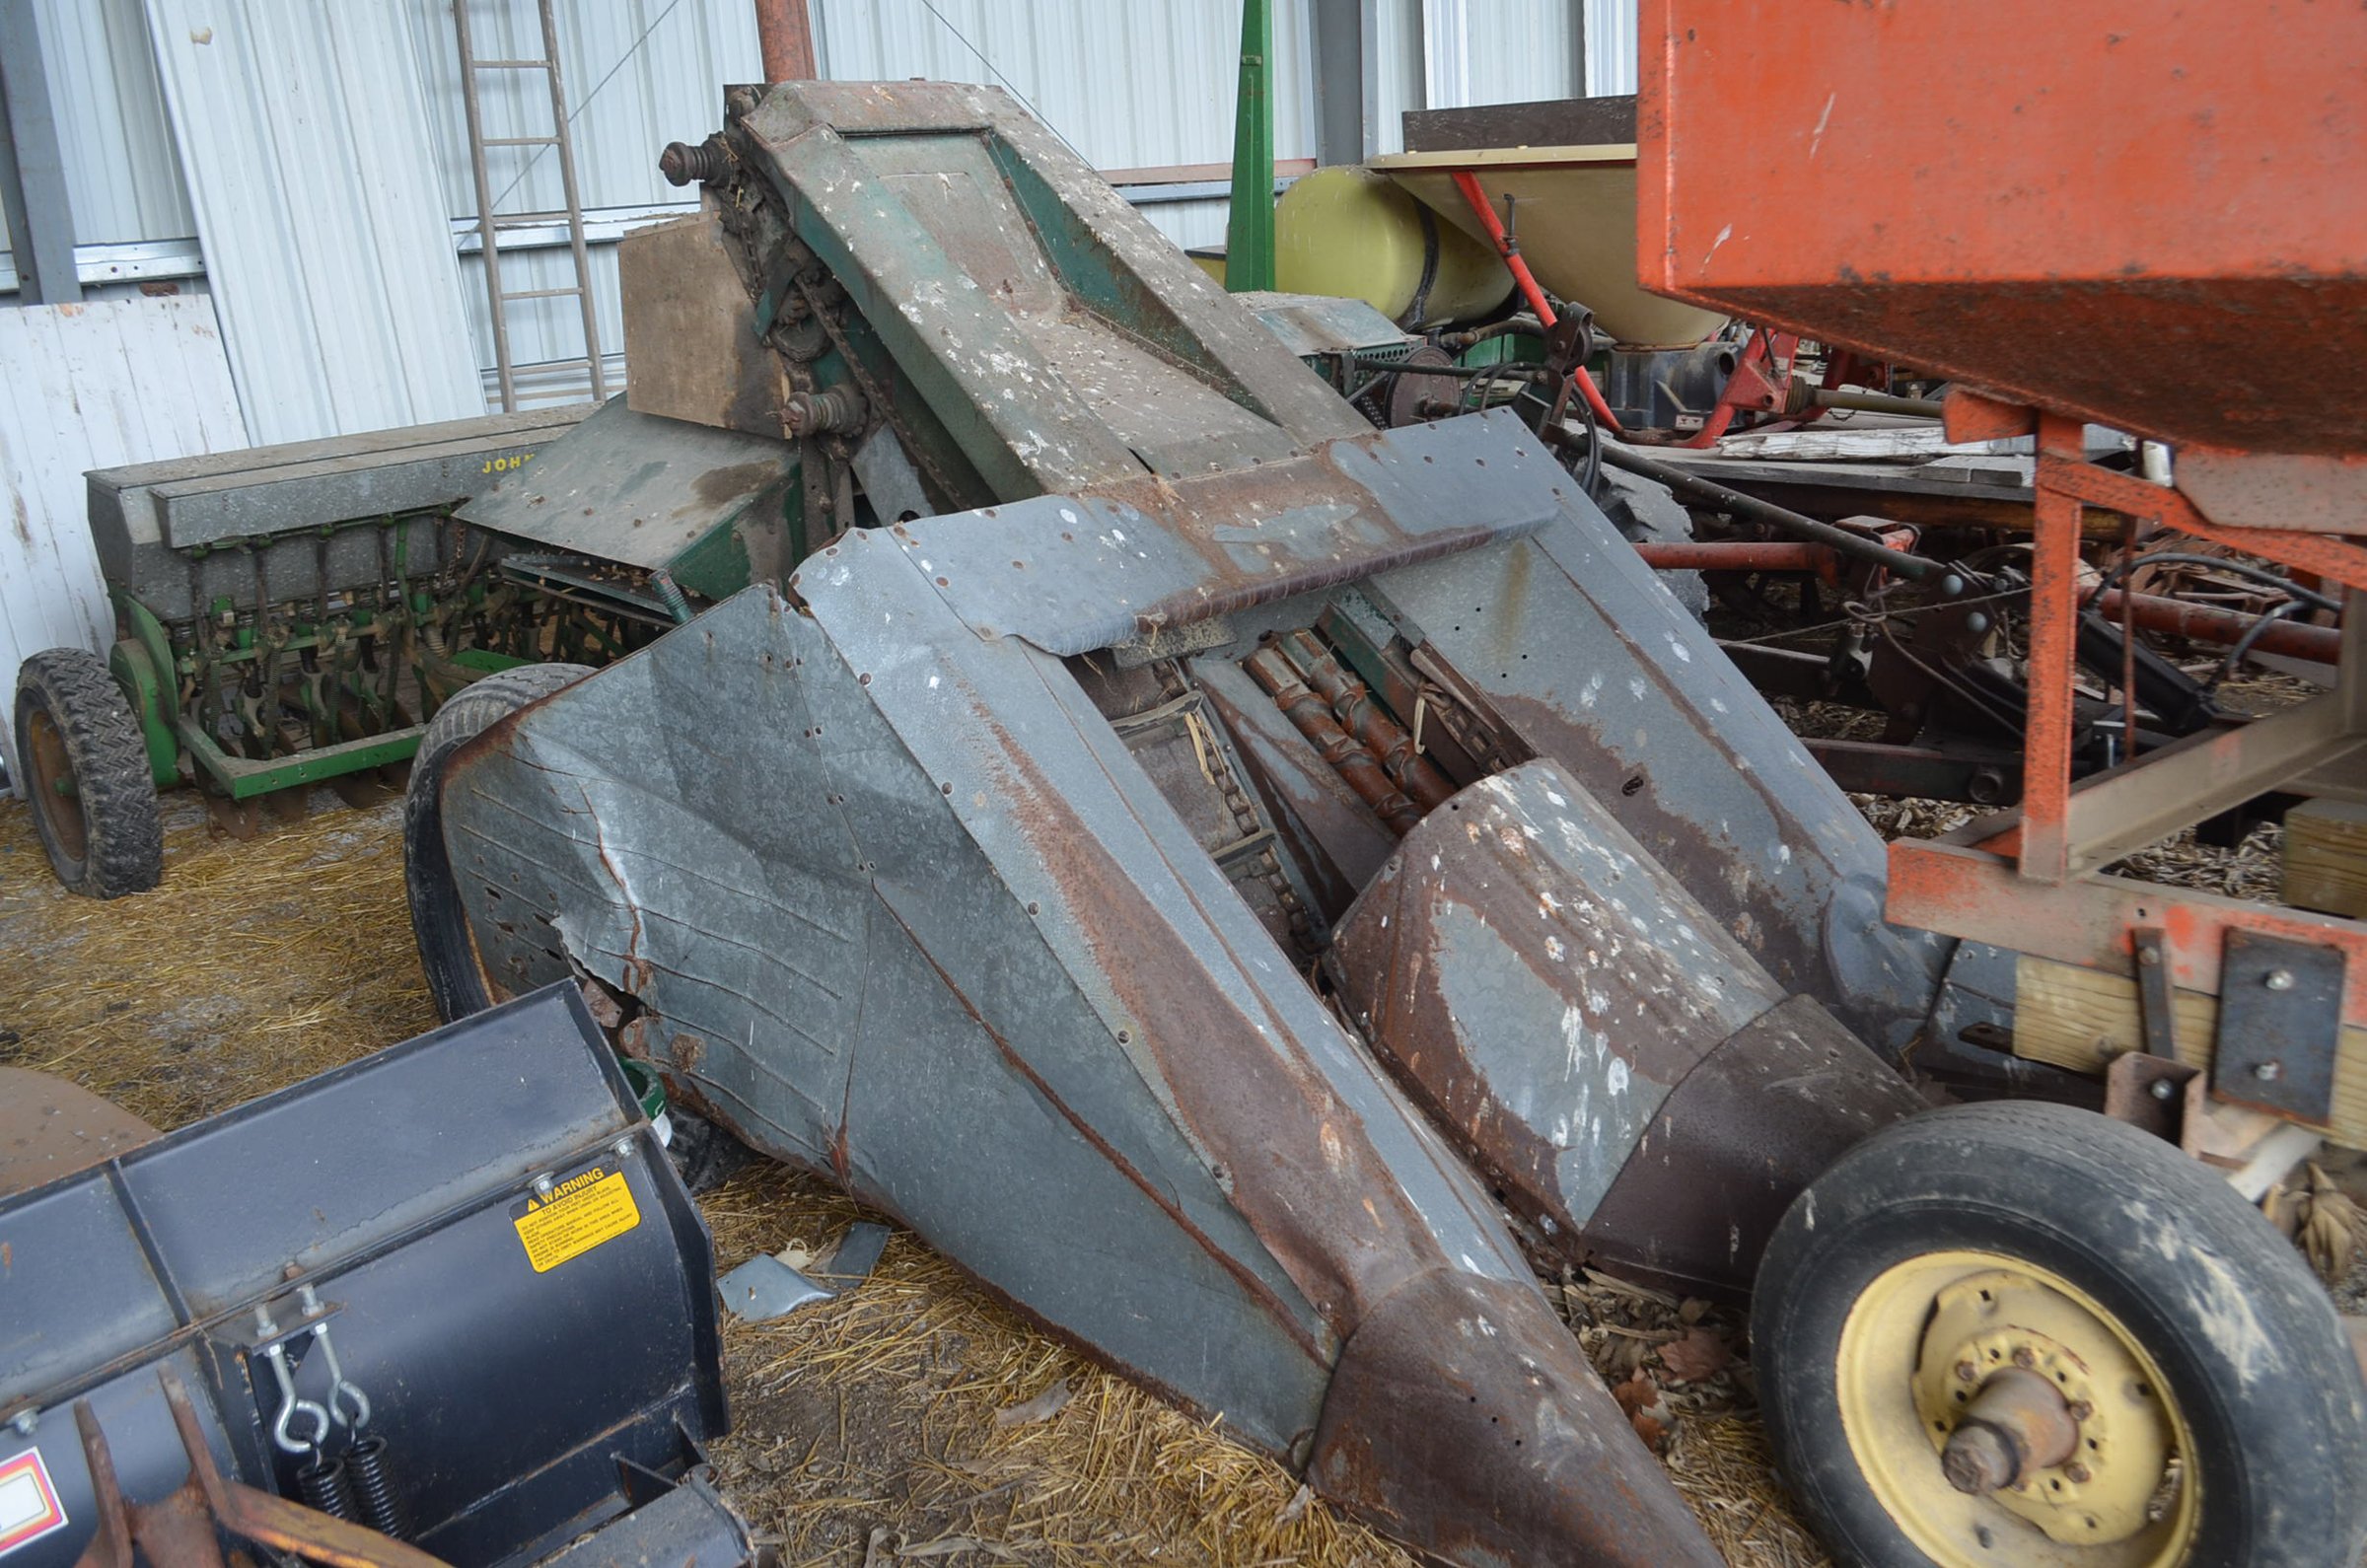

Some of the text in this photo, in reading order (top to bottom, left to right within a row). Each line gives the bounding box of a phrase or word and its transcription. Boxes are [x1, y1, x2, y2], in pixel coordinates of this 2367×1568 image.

[538, 1168, 605, 1203] WARNING
[541, 1184, 597, 1215] TO AVOID INJURY
